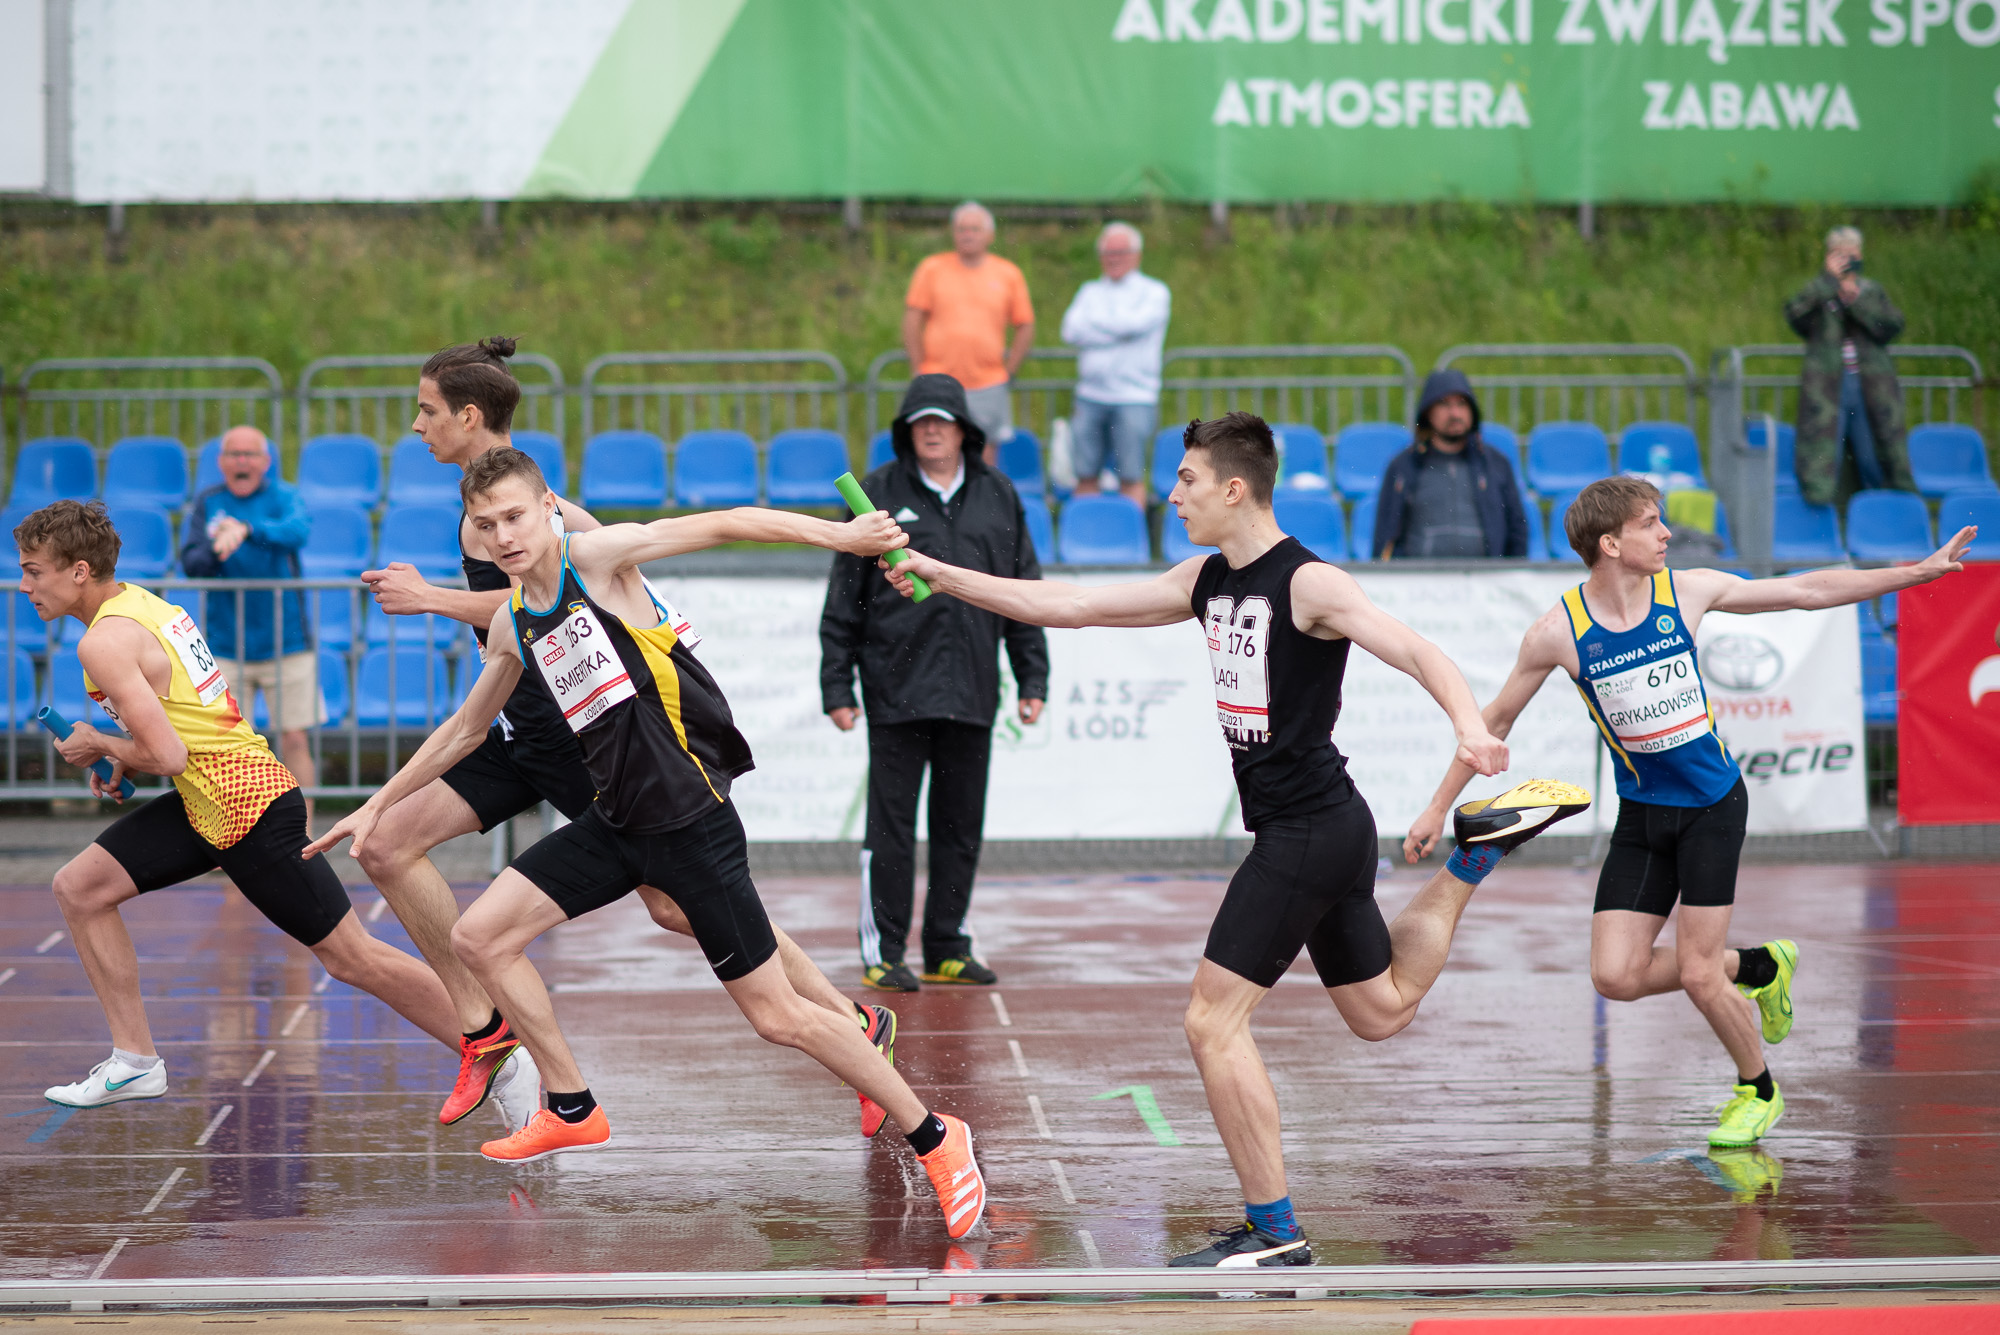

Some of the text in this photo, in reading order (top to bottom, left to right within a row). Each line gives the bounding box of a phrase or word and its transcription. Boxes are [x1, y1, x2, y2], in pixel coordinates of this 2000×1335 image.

[1112, 0, 2000, 65] AKADEMICKI ZWIĄZEK SPO
[1211, 78, 1860, 131] ATMOSFERA ZABAWA
[565, 617, 593, 648] 163
[1229, 632, 1256, 657] 176
[190, 638, 214, 672] 83
[544, 647, 565, 665] ORLEN
[1588, 648, 1646, 675] STALOWA
[1646, 635, 1685, 654] WOLA
[555, 651, 611, 695] ŚMIERTKA
[1647, 660, 1687, 688] 670
[1609, 688, 1700, 727] GRYKAŁOWSKI
[1711, 696, 1792, 720] OYOTA
[1640, 732, 1690, 751] ŁÓDŹ 2021
[1735, 742, 1854, 786] ęcie
